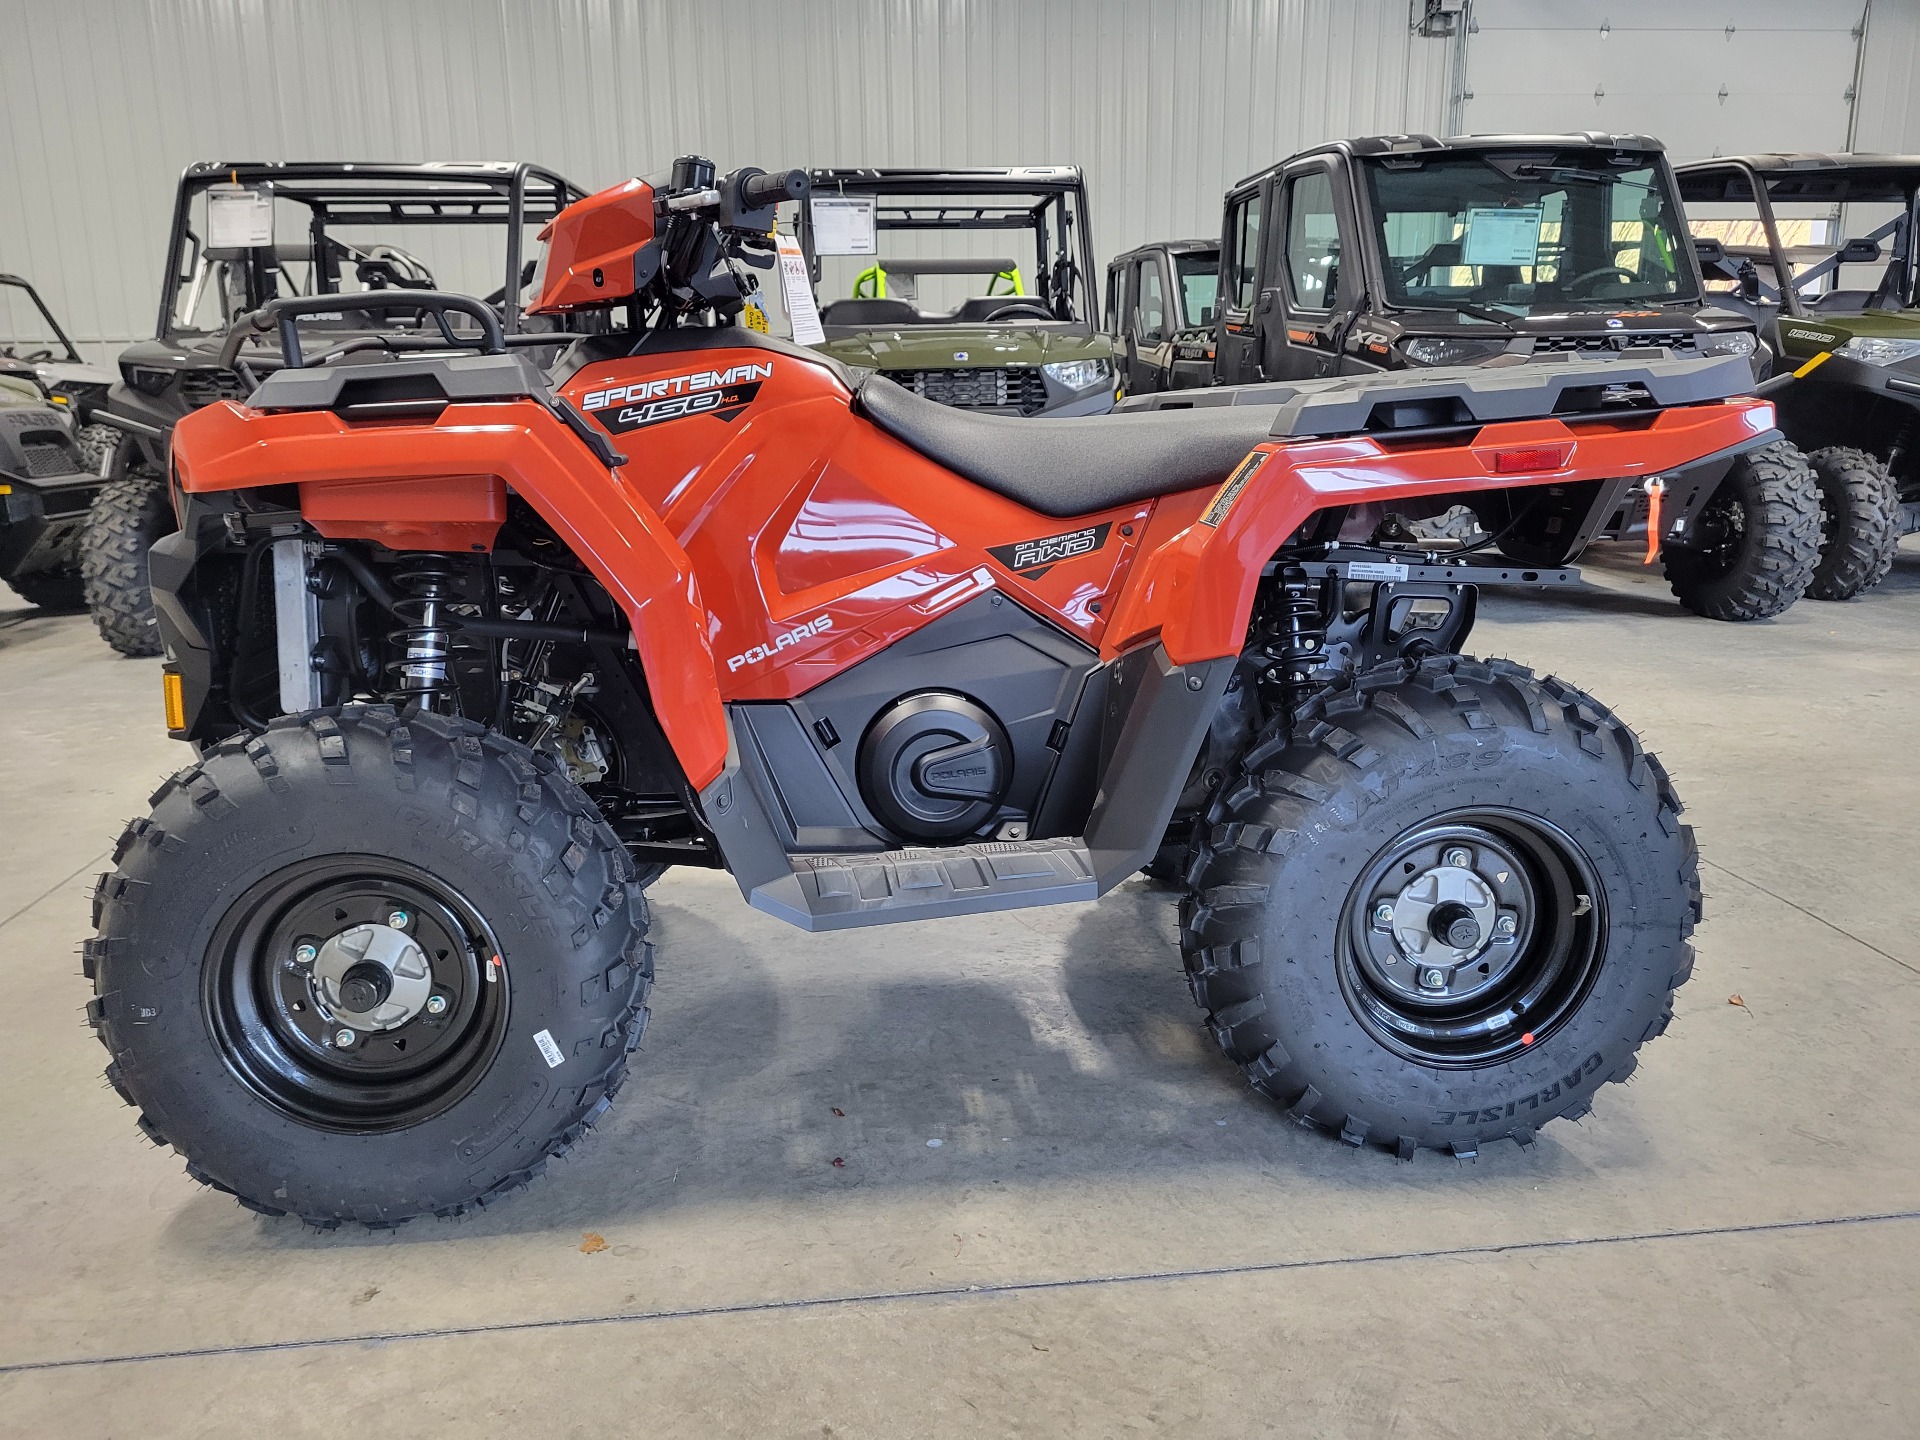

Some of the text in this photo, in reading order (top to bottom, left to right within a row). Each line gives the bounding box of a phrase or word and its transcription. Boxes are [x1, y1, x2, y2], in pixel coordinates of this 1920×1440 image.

[1348, 329, 1388, 345] XP
[1787, 328, 1836, 343] 1000
[1369, 343, 1388, 354] 1000
[581, 361, 774, 412] SPORTSMAN
[618, 390, 723, 424] 450
[1013, 535, 1096, 568] AWD
[1015, 528, 1096, 552] ON DEMAND
[726, 613, 834, 673] POLARIS
[410, 668, 432, 676] SACHS
[930, 766, 987, 781] POLARIS
[1431, 1050, 1604, 1126] CARLISLE
